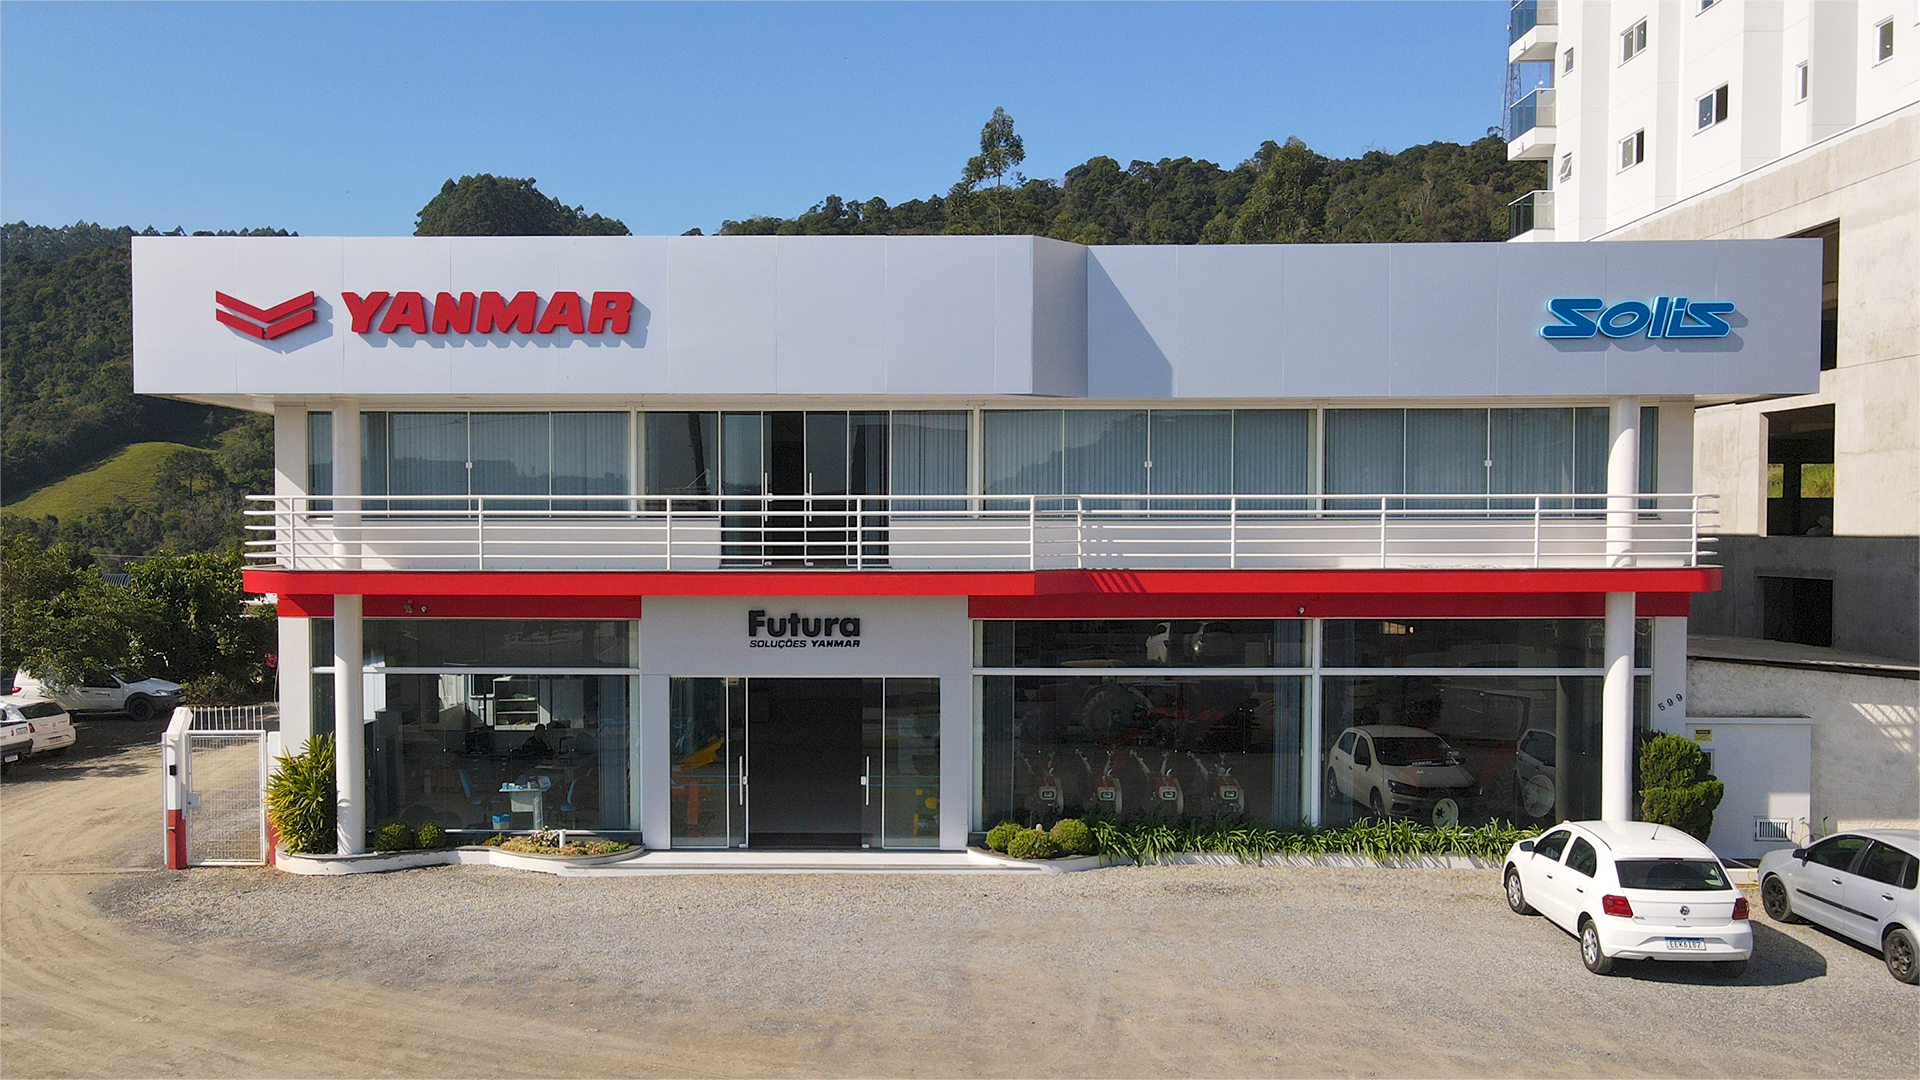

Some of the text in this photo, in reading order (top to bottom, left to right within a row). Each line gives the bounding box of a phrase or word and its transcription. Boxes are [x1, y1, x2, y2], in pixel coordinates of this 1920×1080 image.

[341, 291, 632, 333] YANMAR
[1540, 295, 1736, 339] Solis
[748, 609, 861, 638] Futura
[749, 639, 861, 649] SOLUÇÕES YANMAR
[1657, 693, 1683, 711] 599
